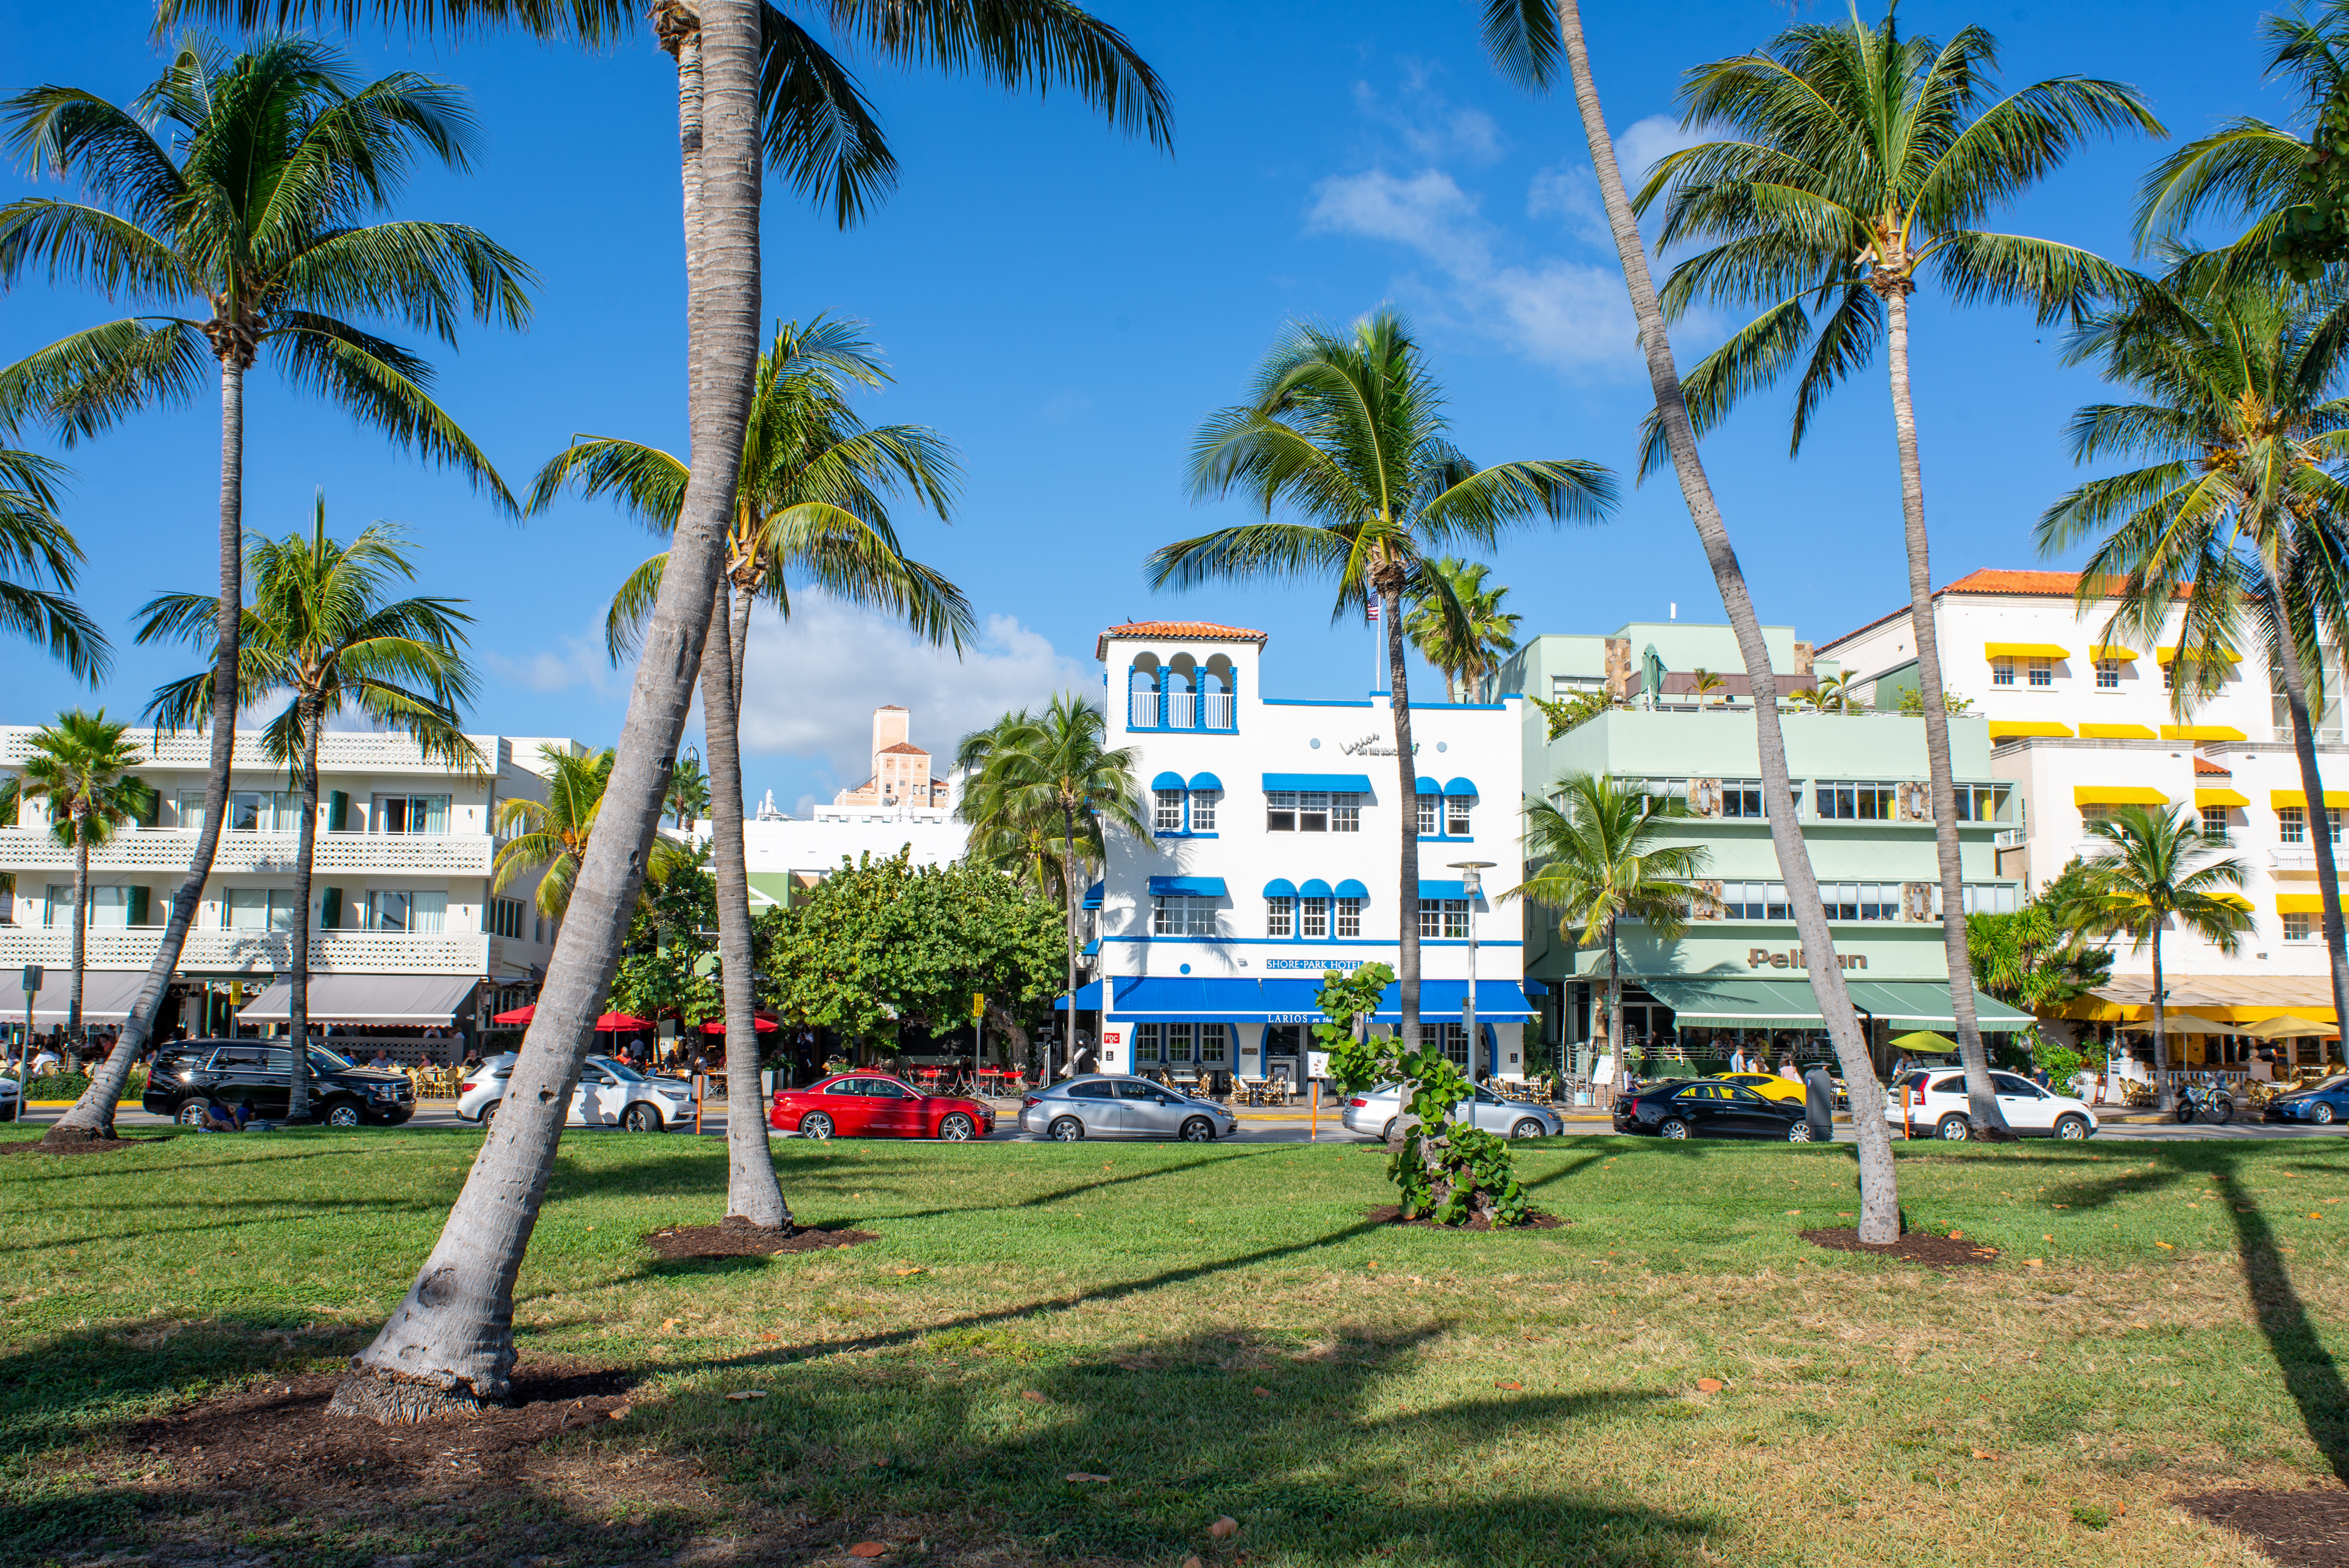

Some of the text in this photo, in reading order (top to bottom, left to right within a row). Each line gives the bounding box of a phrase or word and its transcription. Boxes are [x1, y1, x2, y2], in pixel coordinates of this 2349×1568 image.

[1356, 747, 1399, 757] ON THE BEAC
[1747, 949, 1867, 969] Pelian
[1330, 961, 1361, 969] HOTEL
[1268, 1014, 1307, 1023] LARIOS
